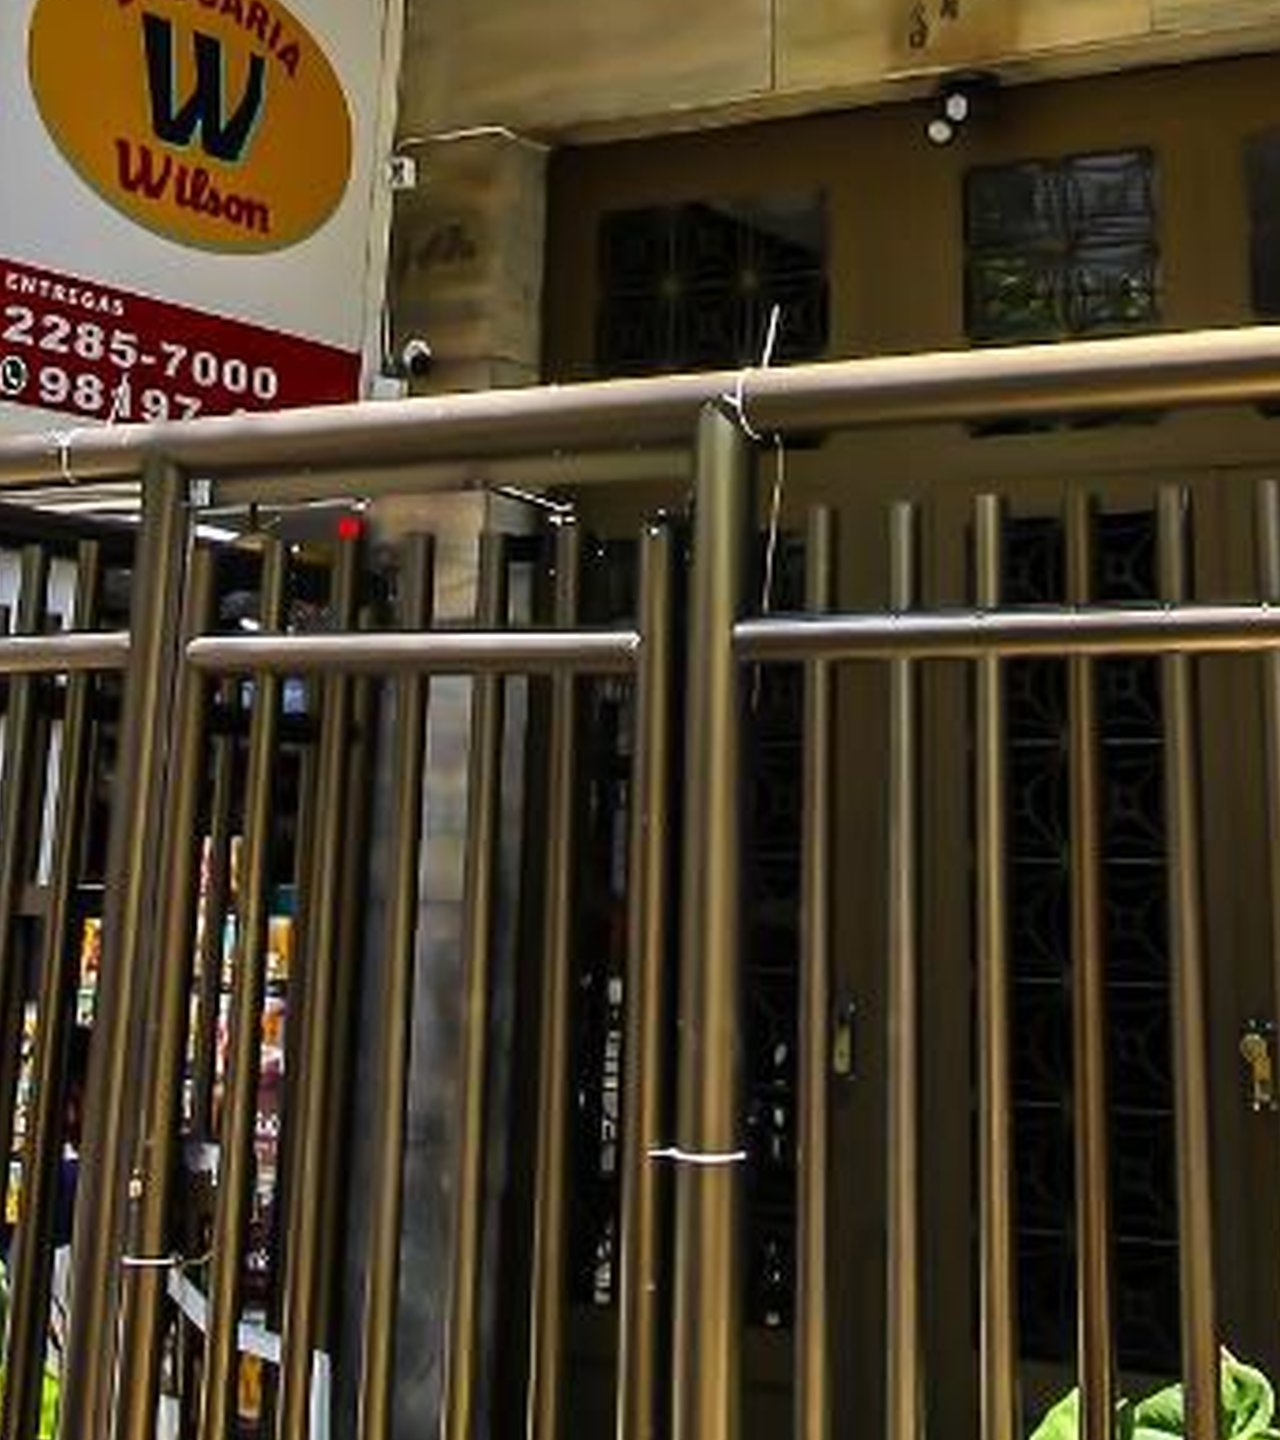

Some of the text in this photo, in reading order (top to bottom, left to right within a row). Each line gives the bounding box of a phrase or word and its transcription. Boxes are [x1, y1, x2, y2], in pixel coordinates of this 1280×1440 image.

[141, 10, 267, 162] W
[114, 138, 272, 234] Wilson
[4, 270, 124, 317] ENTREGAS
[1, 305, 279, 400] 2285-7000
